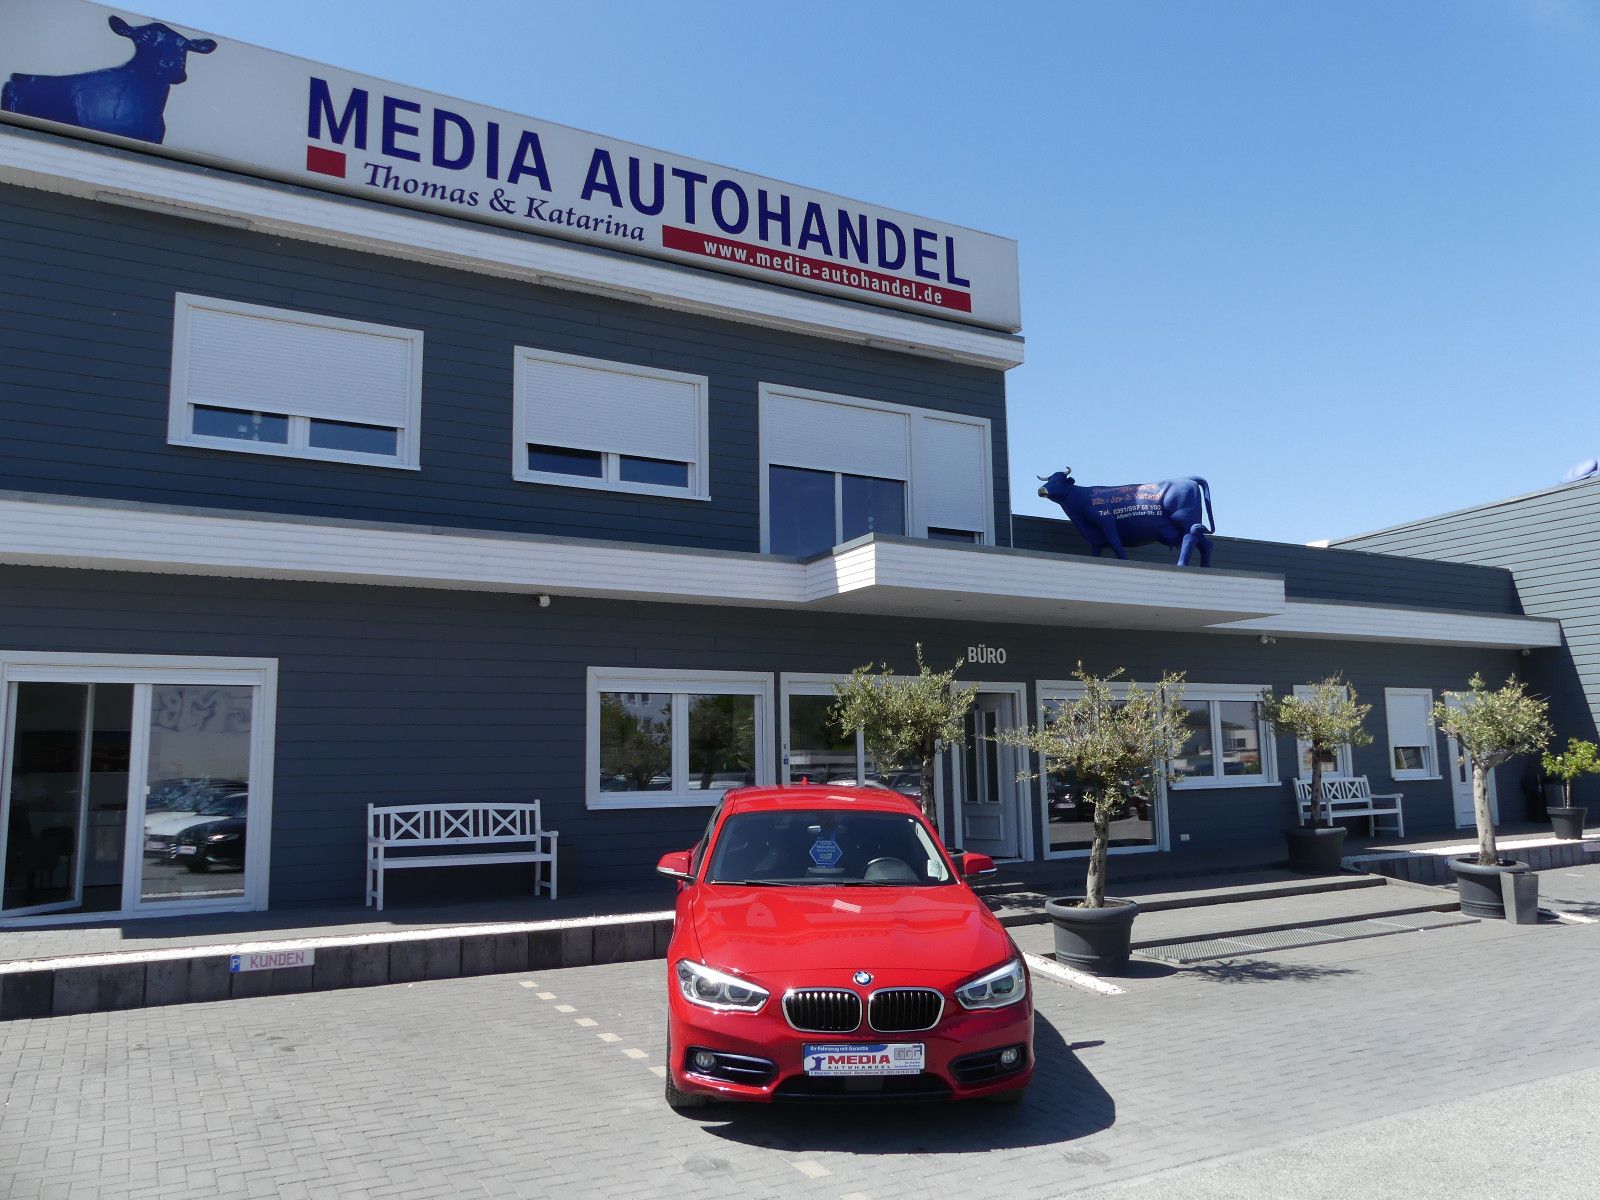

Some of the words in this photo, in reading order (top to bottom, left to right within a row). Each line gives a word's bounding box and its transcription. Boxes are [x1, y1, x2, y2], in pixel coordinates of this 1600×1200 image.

[308, 77, 552, 192] MEDIA
[581, 148, 970, 288] AUTOHANDEL
[364, 162, 479, 207] Thomas
[489, 188, 516, 214] &
[524, 197, 645, 242] Katarina
[704, 241, 942, 305] www.media-autohandel.de
[967, 643, 1007, 664] BÜRO
[250, 952, 304, 968] KUNDEN
[828, 1055, 890, 1064] MEDIA
